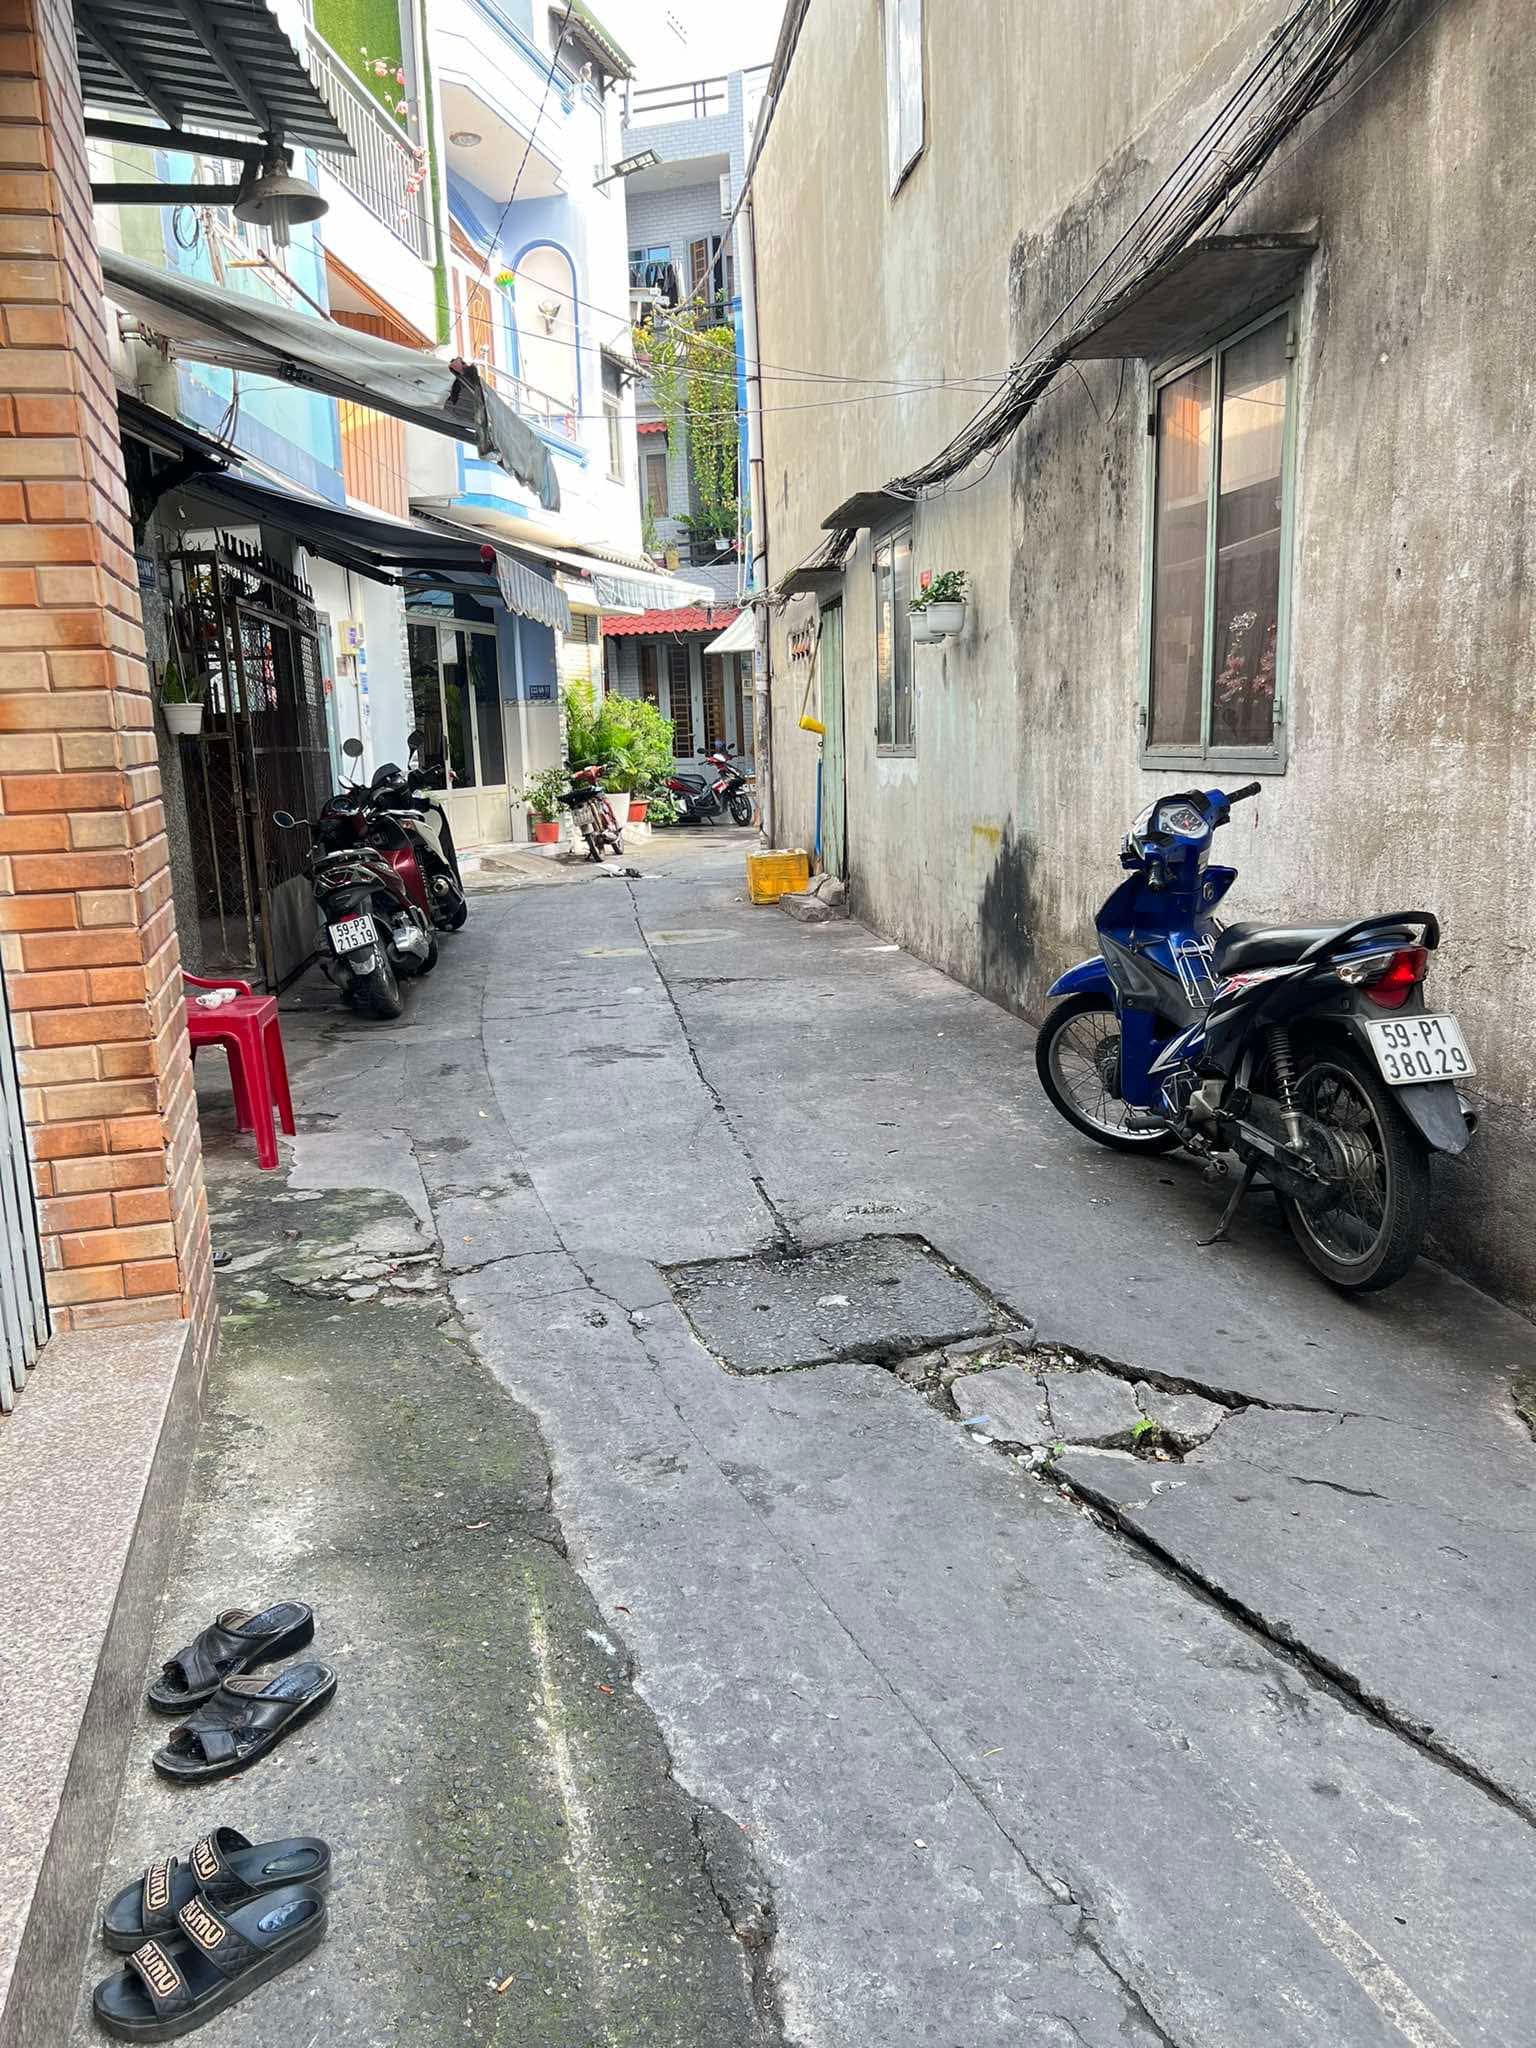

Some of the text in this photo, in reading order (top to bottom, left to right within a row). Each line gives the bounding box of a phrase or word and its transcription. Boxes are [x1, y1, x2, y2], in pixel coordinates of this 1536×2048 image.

[337, 918, 366, 937] 59-P3
[338, 929, 373, 950] 215.19
[1381, 1020, 1446, 1048] 59-P1
[1385, 1047, 1467, 1078] 380.29
